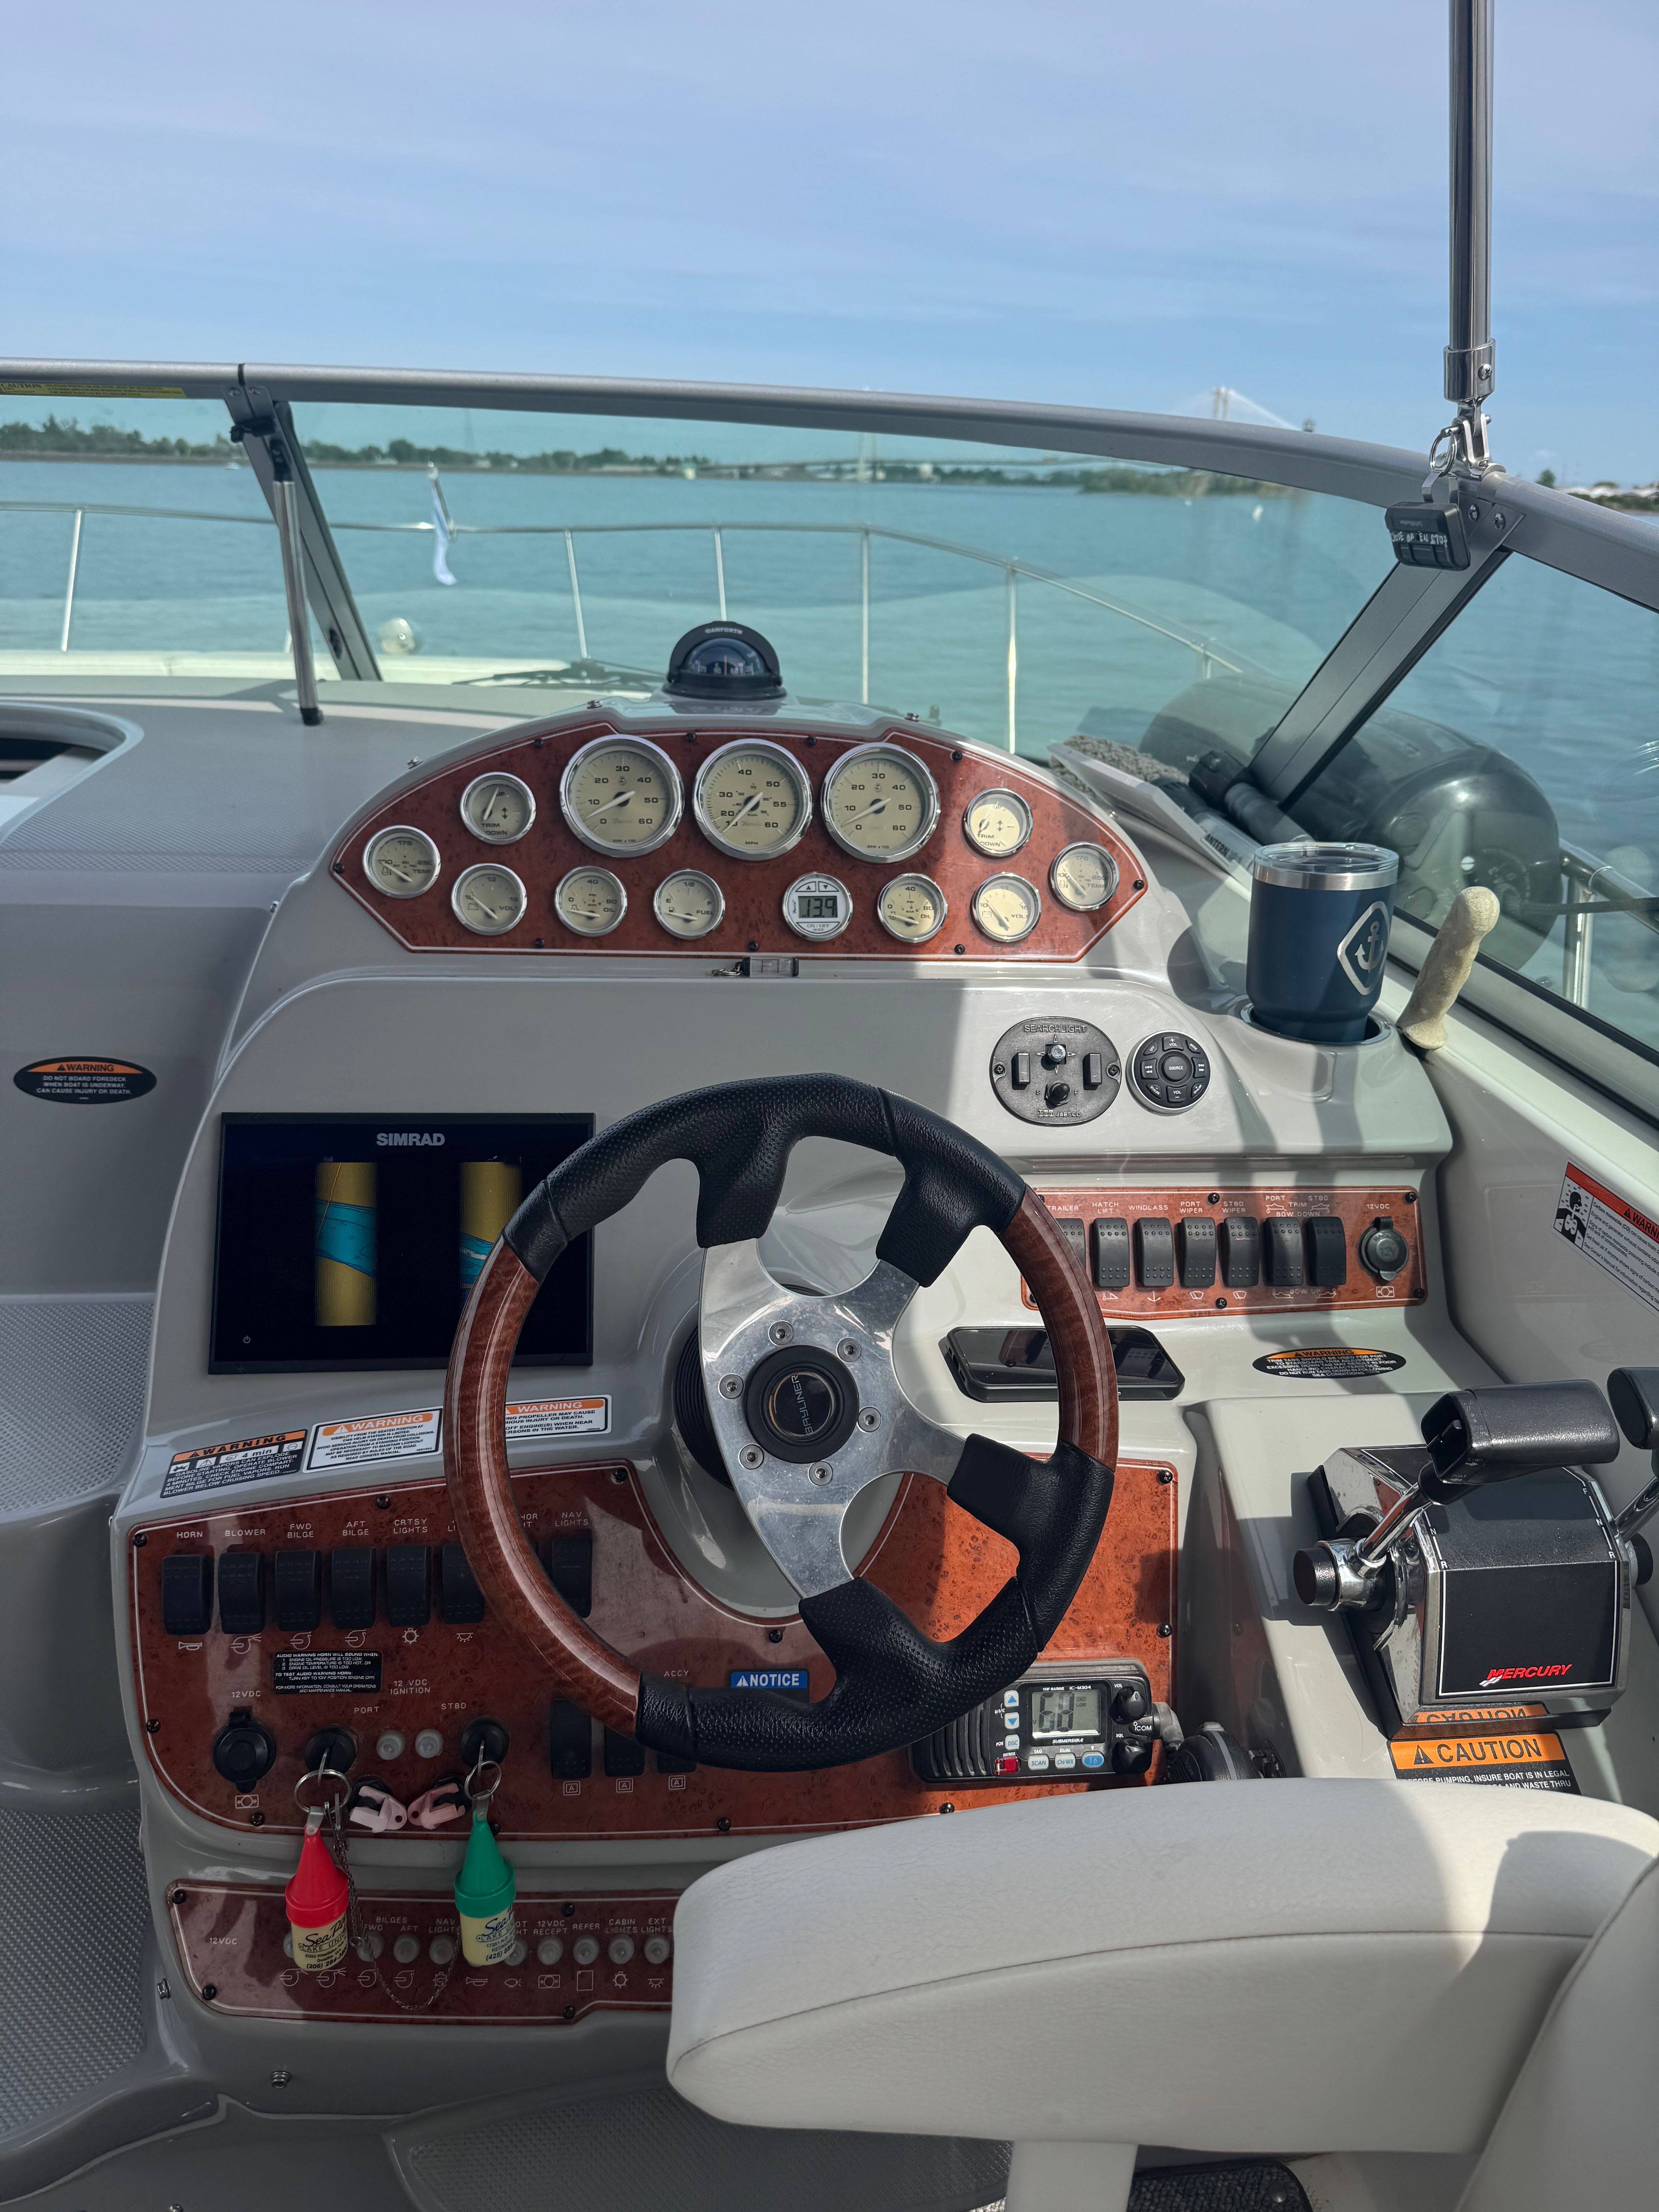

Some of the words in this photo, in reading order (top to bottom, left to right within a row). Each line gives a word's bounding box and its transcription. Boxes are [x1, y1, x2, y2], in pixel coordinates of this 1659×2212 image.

[1024, 1024, 1086, 1034] SEARCHLIGHT
[376, 1133, 445, 1147] SIMRAD
[517, 1401, 582, 1413] WARNING
[791, 1374, 814, 1434] BAYLINER
[351, 1415, 423, 1431] WARNING
[203, 1434, 286, 1456] WARNING
[1487, 1664, 1572, 1680] MERCURY
[749, 1673, 800, 1686] NOTICE
[232, 1690, 261, 1698] 12VDC
[390, 1687, 431, 1695] IGNITION
[354, 1706, 380, 1714] PORT
[1436, 1738, 1542, 1763] CAUTION
[1548, 1769, 1570, 1778] LEGAL
[1522, 1781, 1549, 1790] WASTE
[1549, 1780, 1571, 1788] THRU
[483, 1917, 508, 1937] Sea
[533, 1927, 568, 1935] RECEPT
[209, 1937, 237, 1945] 12VDC
[303, 1933, 331, 1947] Sea
[481, 1931, 502, 1941] LAKE
[486, 1951, 503, 1961] (425)
